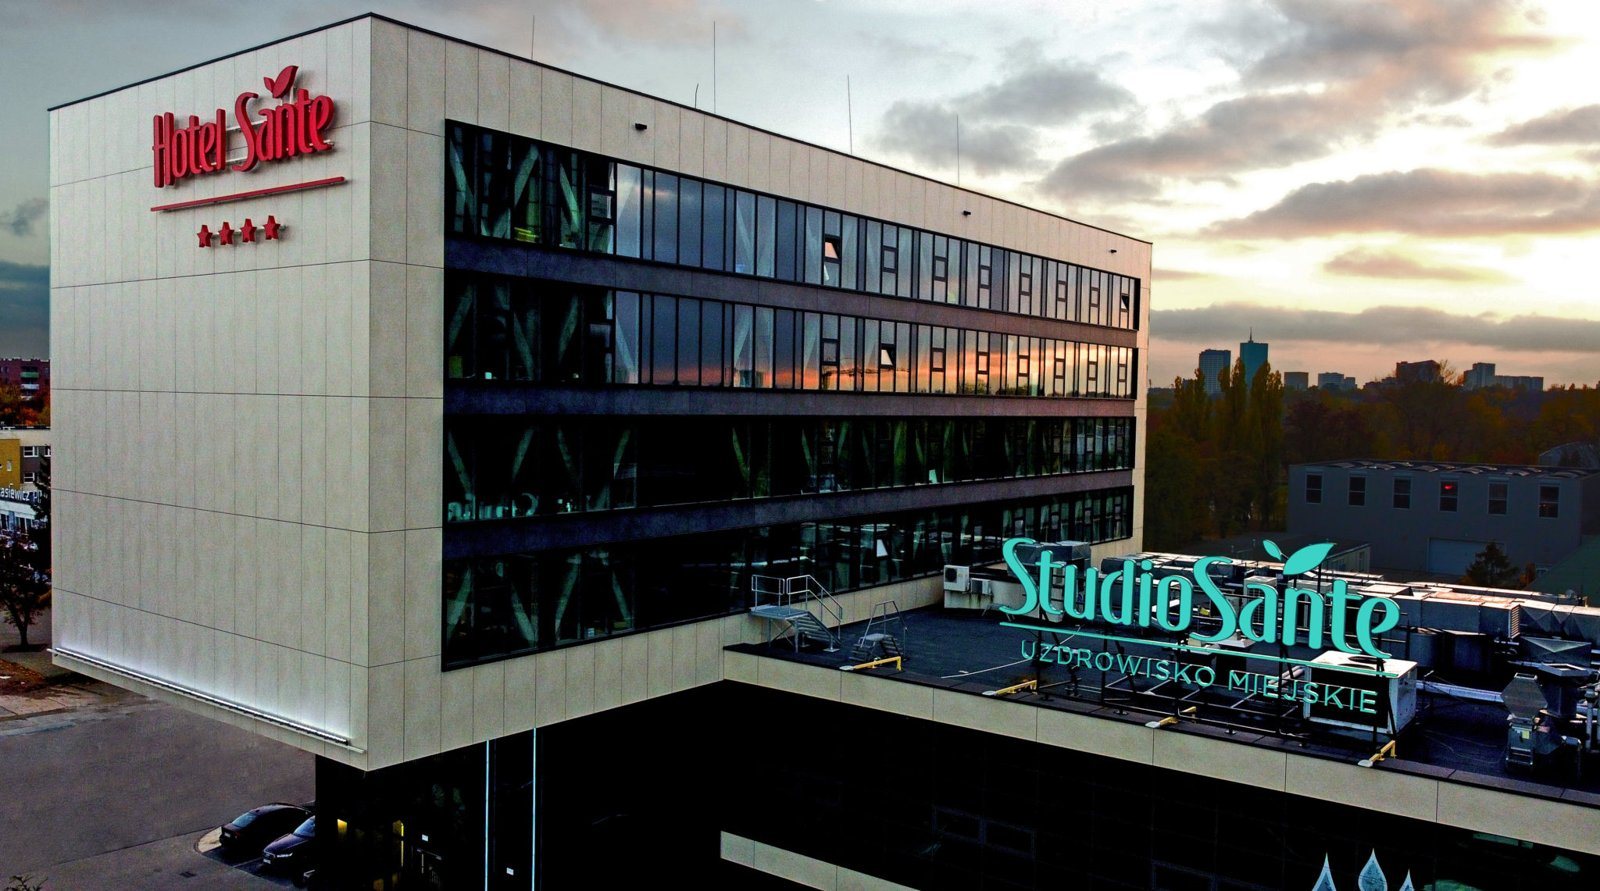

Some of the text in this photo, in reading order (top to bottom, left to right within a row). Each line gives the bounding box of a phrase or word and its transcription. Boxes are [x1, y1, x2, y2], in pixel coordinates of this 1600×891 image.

[153, 88, 334, 188] Hotel Sante
[1021, 639, 1378, 714] UZDROWISKO MIEJSKIE
